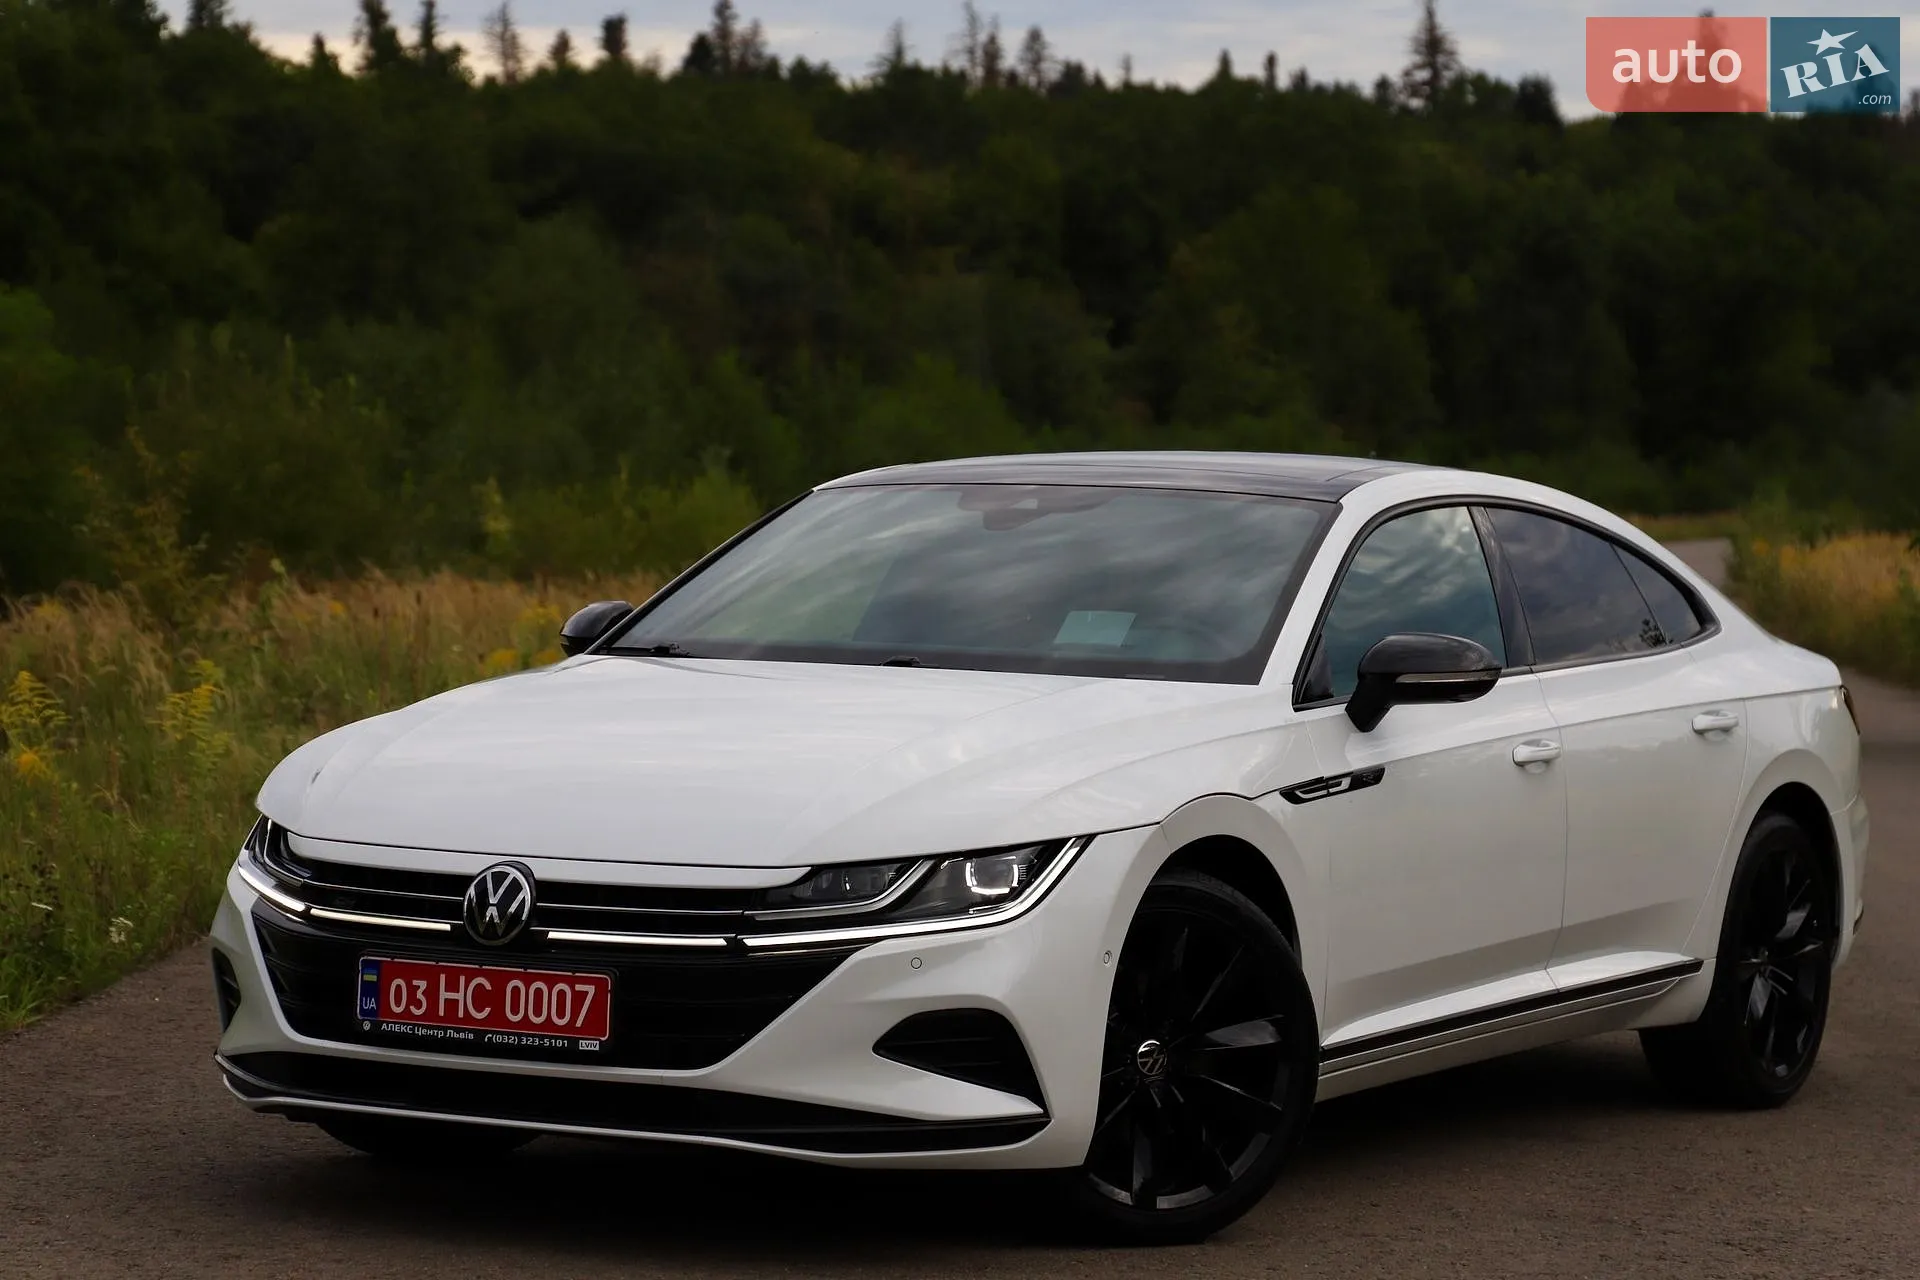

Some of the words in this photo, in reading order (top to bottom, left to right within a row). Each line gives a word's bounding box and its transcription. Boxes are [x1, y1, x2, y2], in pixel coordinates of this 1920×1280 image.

[362, 997, 377, 1010] UA
[389, 978, 428, 1015] 03
[438, 973, 492, 1020] HC
[505, 979, 596, 1027] 0007
[381, 1023, 413, 1035] АЛЕКС
[414, 1027, 444, 1039] Центр
[446, 1029, 474, 1040] Львів
[492, 1032, 518, 1045] (032)
[520, 1036, 568, 1048] 323-5101
[580, 1041, 598, 1050] LVIV
